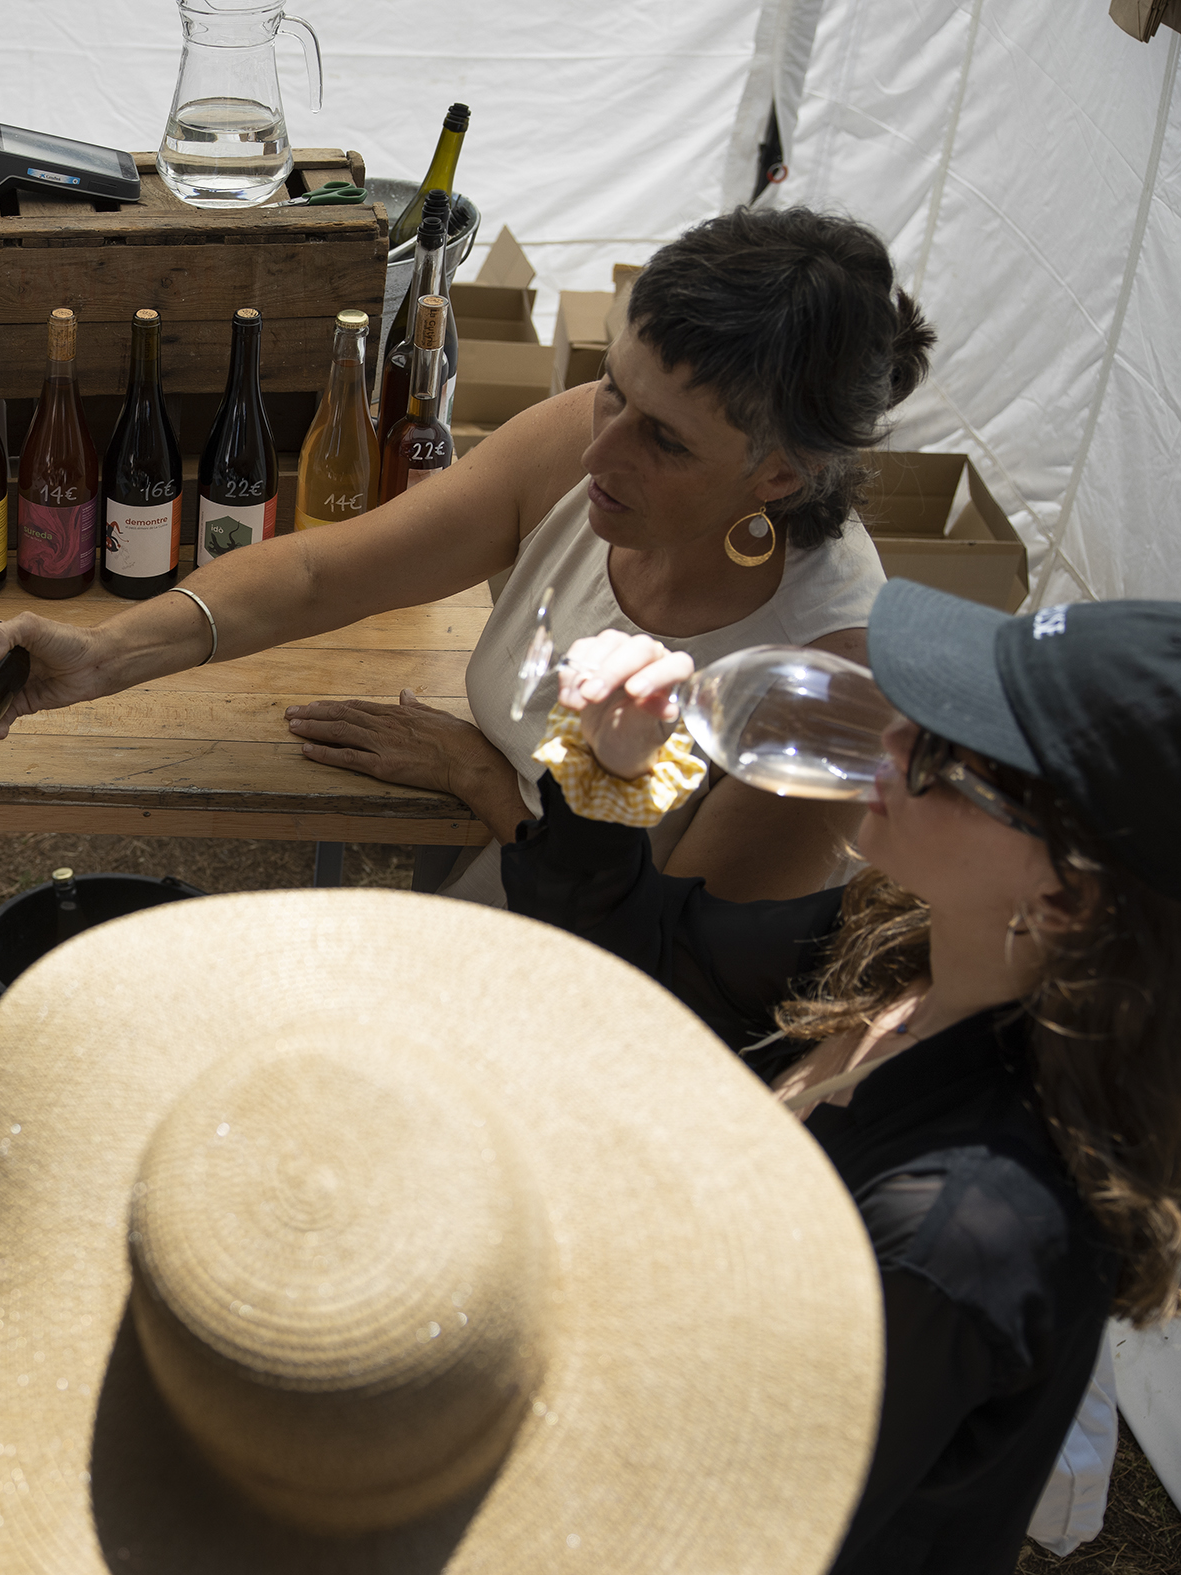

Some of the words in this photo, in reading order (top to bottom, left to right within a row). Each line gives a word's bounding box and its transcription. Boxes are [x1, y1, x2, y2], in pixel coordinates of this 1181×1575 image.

[411, 441, 446, 461] 22€
[40, 484, 78, 504] 14€
[140, 479, 175, 501] 16€
[225, 480, 263, 498] 22€
[324, 493, 363, 512] 14€
[125, 516, 168, 526] demontre
[24, 526, 53, 540] sureda
